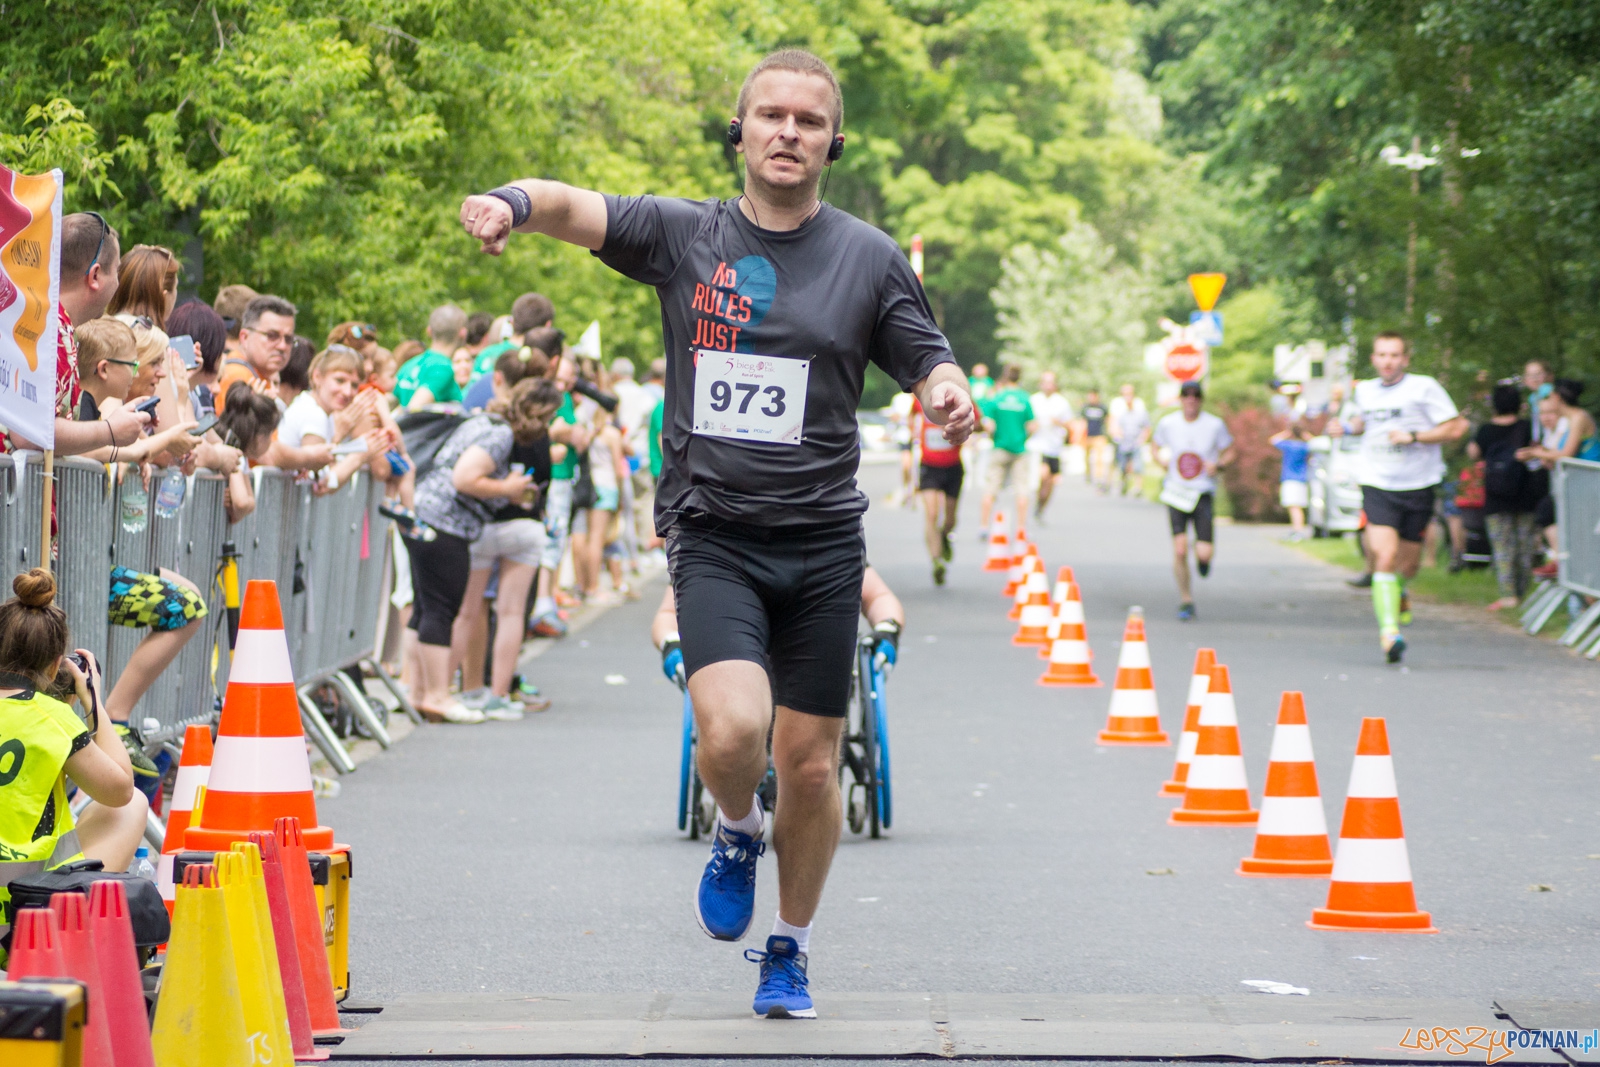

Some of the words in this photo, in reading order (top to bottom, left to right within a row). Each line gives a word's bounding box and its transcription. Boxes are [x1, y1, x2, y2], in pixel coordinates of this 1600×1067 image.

[711, 262, 737, 289] NO
[691, 282, 753, 323] RULES
[691, 318, 742, 353] JUST
[724, 357, 734, 376] 5
[736, 359, 756, 373] bieg
[710, 380, 787, 418] 973
[246, 1031, 274, 1064] TS
